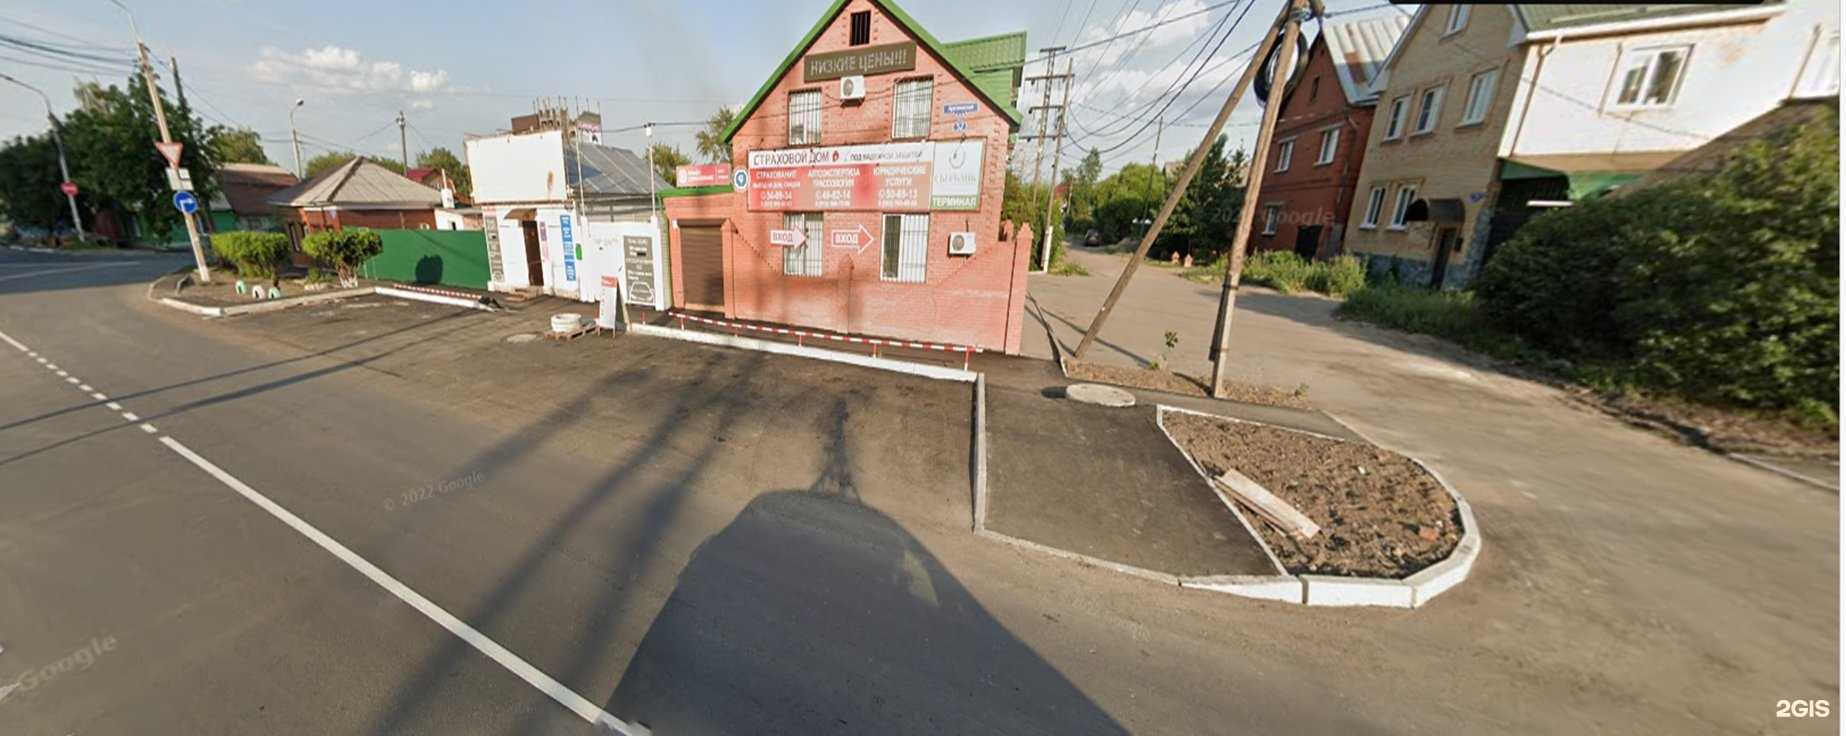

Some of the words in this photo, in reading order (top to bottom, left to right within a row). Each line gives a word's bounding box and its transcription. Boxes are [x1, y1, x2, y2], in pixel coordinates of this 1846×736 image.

[810, 55, 857, 76] НИЗКИЕ
[859, 48, 908, 72] ЦЕНЫ!!!
[753, 152, 807, 166] СТРАХОВОЙ
[809, 151, 829, 164] ДОМ
[873, 166, 926, 176] ЮРИДИЧЕСКИЕ
[885, 177, 912, 187] УСЛУГИ
[933, 195, 977, 209] ТЕРМИНАЛ
[772, 231, 793, 243] ВХОД
[834, 231, 858, 245] ВХОД
